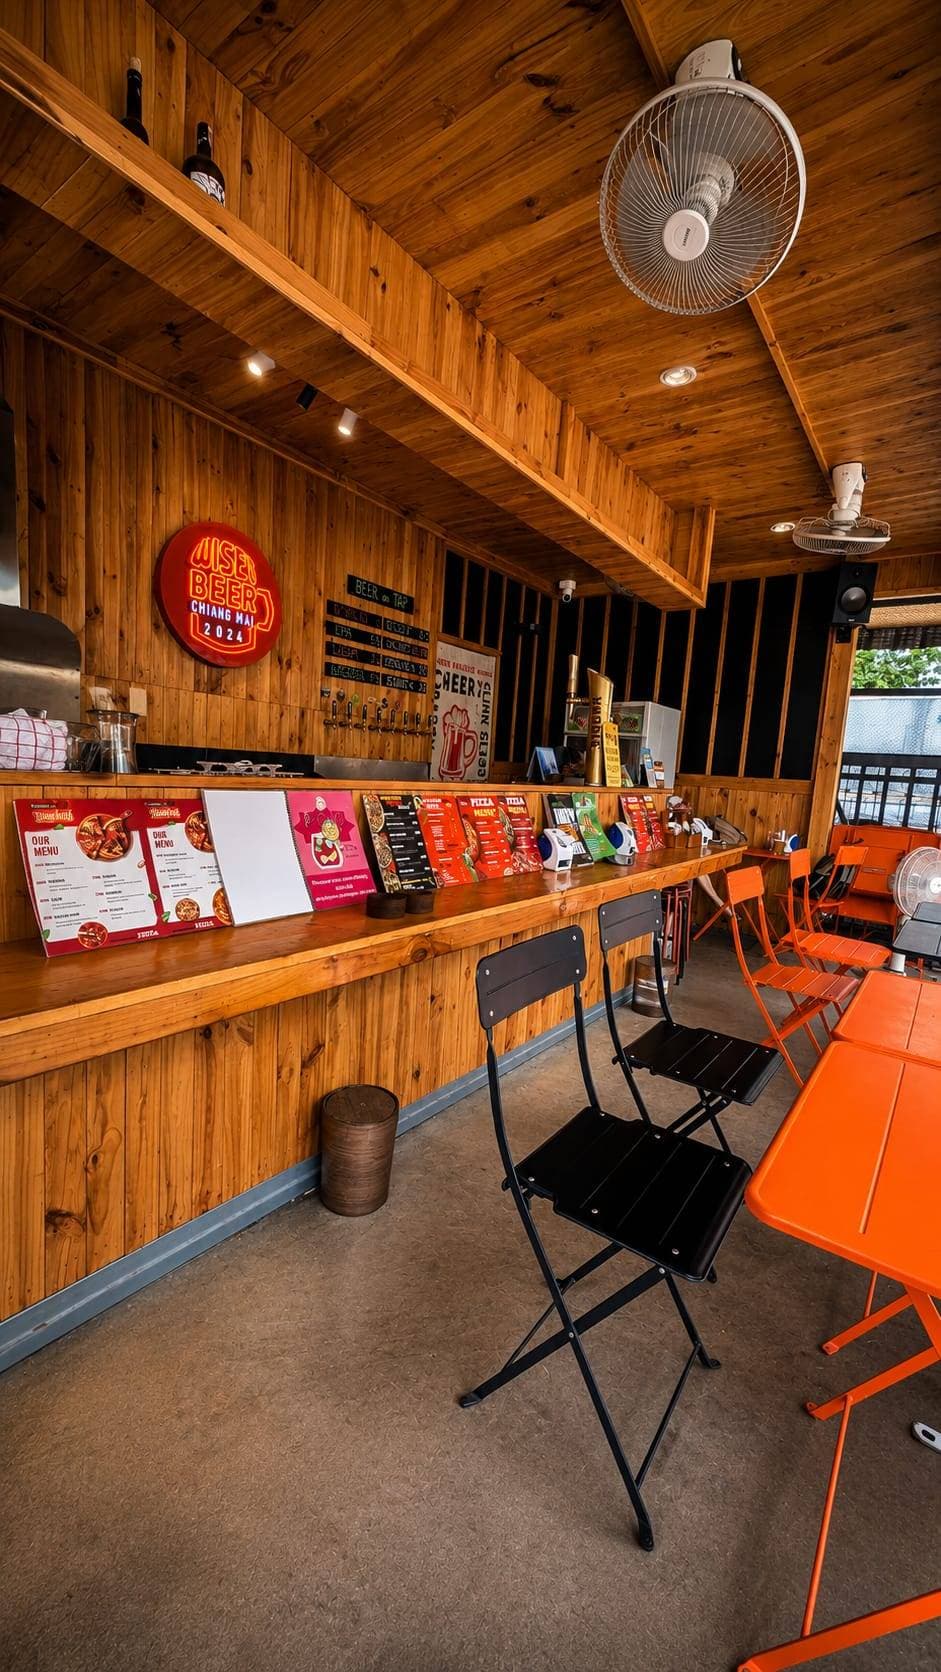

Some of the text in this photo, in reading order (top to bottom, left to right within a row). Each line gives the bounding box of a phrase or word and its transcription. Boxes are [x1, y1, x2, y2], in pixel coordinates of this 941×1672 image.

[190, 568, 257, 613] BEER
[355, 579, 378, 600] BEER
[393, 592, 408, 608] TAP
[191, 599, 254, 629] CHIANG MAI
[204, 622, 243, 643] 2024
[32, 836, 50, 846] OUR
[34, 846, 59, 857] MENU
